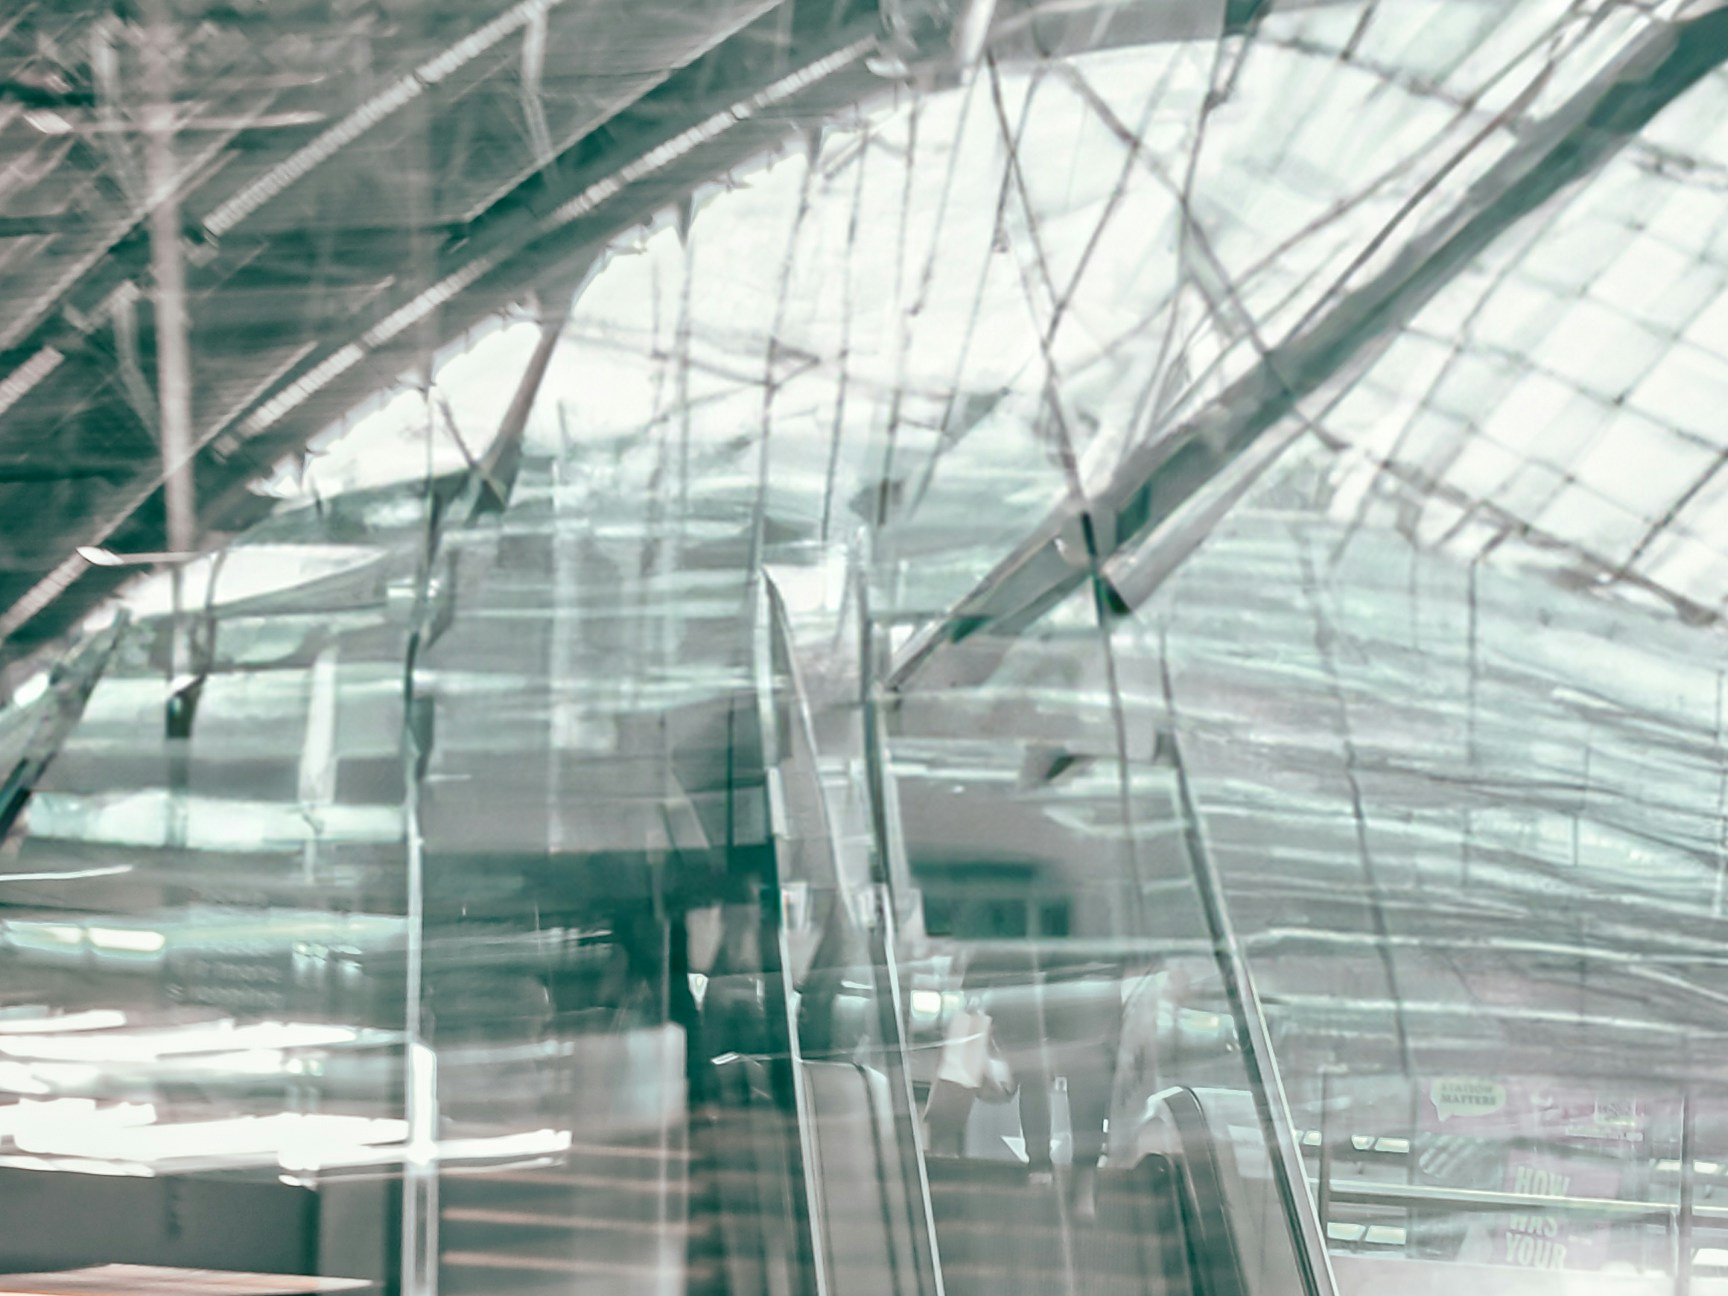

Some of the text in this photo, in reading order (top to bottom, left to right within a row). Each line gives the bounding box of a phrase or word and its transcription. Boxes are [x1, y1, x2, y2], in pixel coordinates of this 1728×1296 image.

[1440, 1093, 1497, 1106] MATTERS
[1514, 1166, 1570, 1197] HOW
[1505, 1232, 1567, 1269] YOUR
